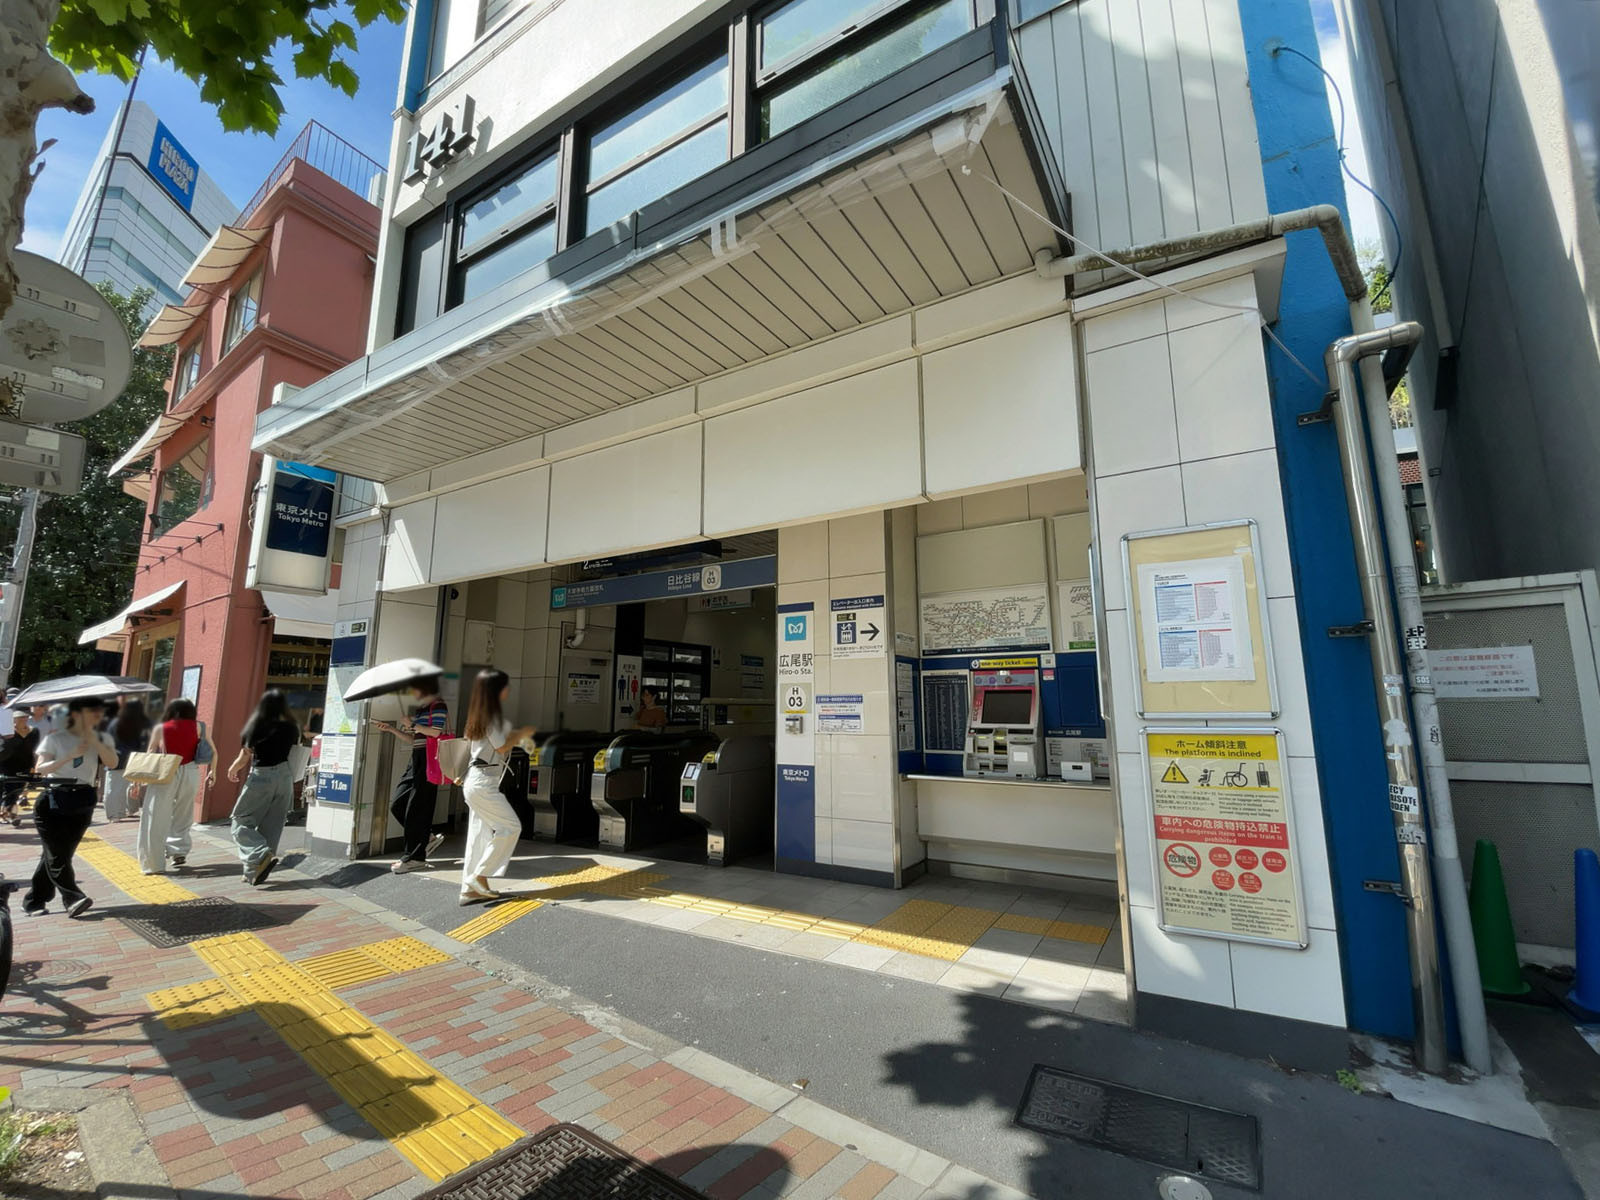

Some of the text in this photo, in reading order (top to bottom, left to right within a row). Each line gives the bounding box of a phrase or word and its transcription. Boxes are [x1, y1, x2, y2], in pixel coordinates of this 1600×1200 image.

[403, 93, 476, 187] 141
[275, 502, 328, 521] 東京メトロ
[278, 512, 324, 527] Tokyo Metro
[667, 572, 701, 586] 日比谷線
[779, 653, 813, 667] 広尾駅
[792, 687, 799, 695] H
[788, 696, 803, 707] 03
[1176, 740, 1247, 750] ホーム傾斜注意
[1181, 749, 1217, 757] platform
[1160, 826, 1185, 834] Carrying
[1186, 828, 1218, 836] dangerous
[1161, 817, 1281, 834] 車内への危険物持込禁止
